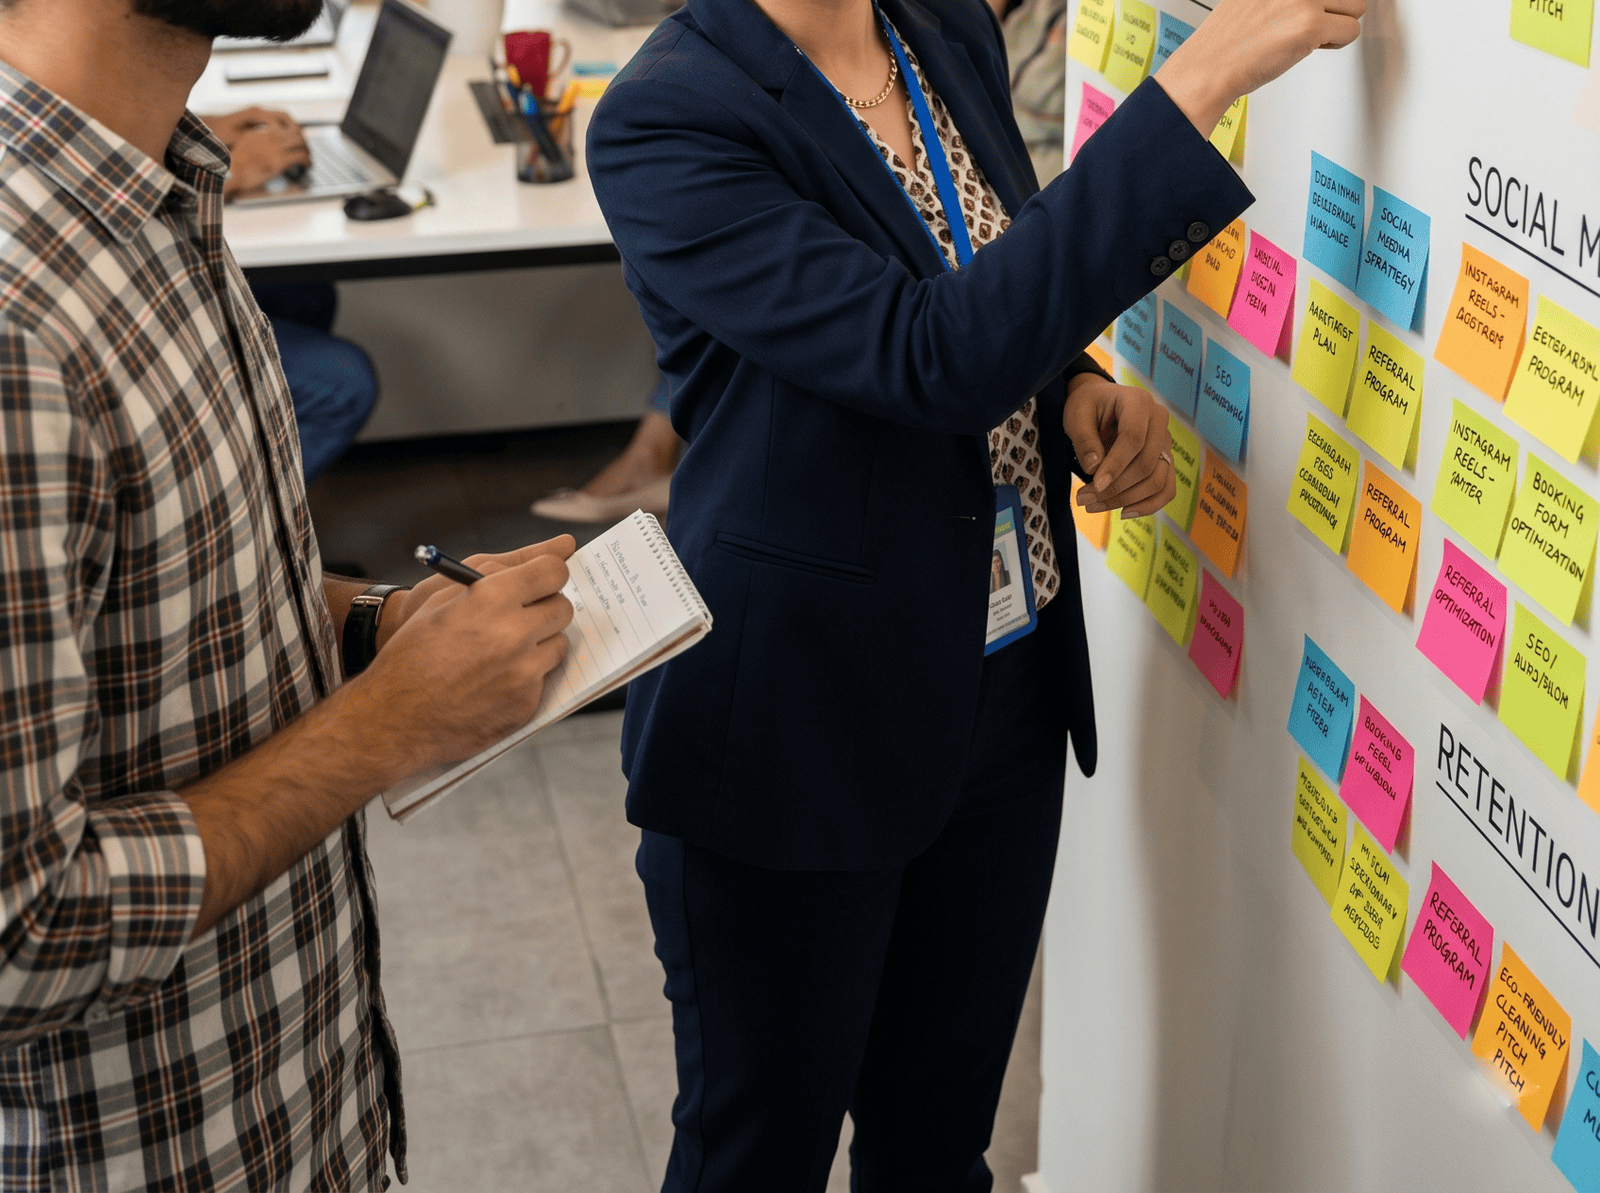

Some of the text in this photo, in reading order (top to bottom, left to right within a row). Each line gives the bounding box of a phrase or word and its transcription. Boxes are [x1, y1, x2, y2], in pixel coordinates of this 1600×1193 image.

[1381, 207, 1414, 239] SOCIAL
[1467, 156, 1564, 256] SOCIAL
[1465, 261, 1519, 309] INSTAGRAM
[1364, 370, 1408, 415] PROGRAM
[1368, 344, 1415, 391] REFERRAL
[1527, 355, 1585, 407] PROGRAM
[1453, 419, 1511, 472] INSTAGRAM
[1454, 447, 1488, 480] REELS
[1366, 483, 1410, 529] REFERRAL
[1532, 471, 1584, 525] BOOKING
[1534, 502, 1569, 539] FORM
[1364, 507, 1407, 554] PROGRAM
[1511, 517, 1585, 582] OPTIMIZATION
[1438, 722, 1600, 939] RETENTION
[1423, 919, 1475, 990] PROGRAM
[1430, 892, 1482, 967] REFERRAL
[1496, 994, 1546, 1060] CLEANING
[1500, 967, 1566, 1051] ECO-FRIENDLY
[1496, 1021, 1528, 1065] PITCH
[1493, 1048, 1525, 1093] PITCH
